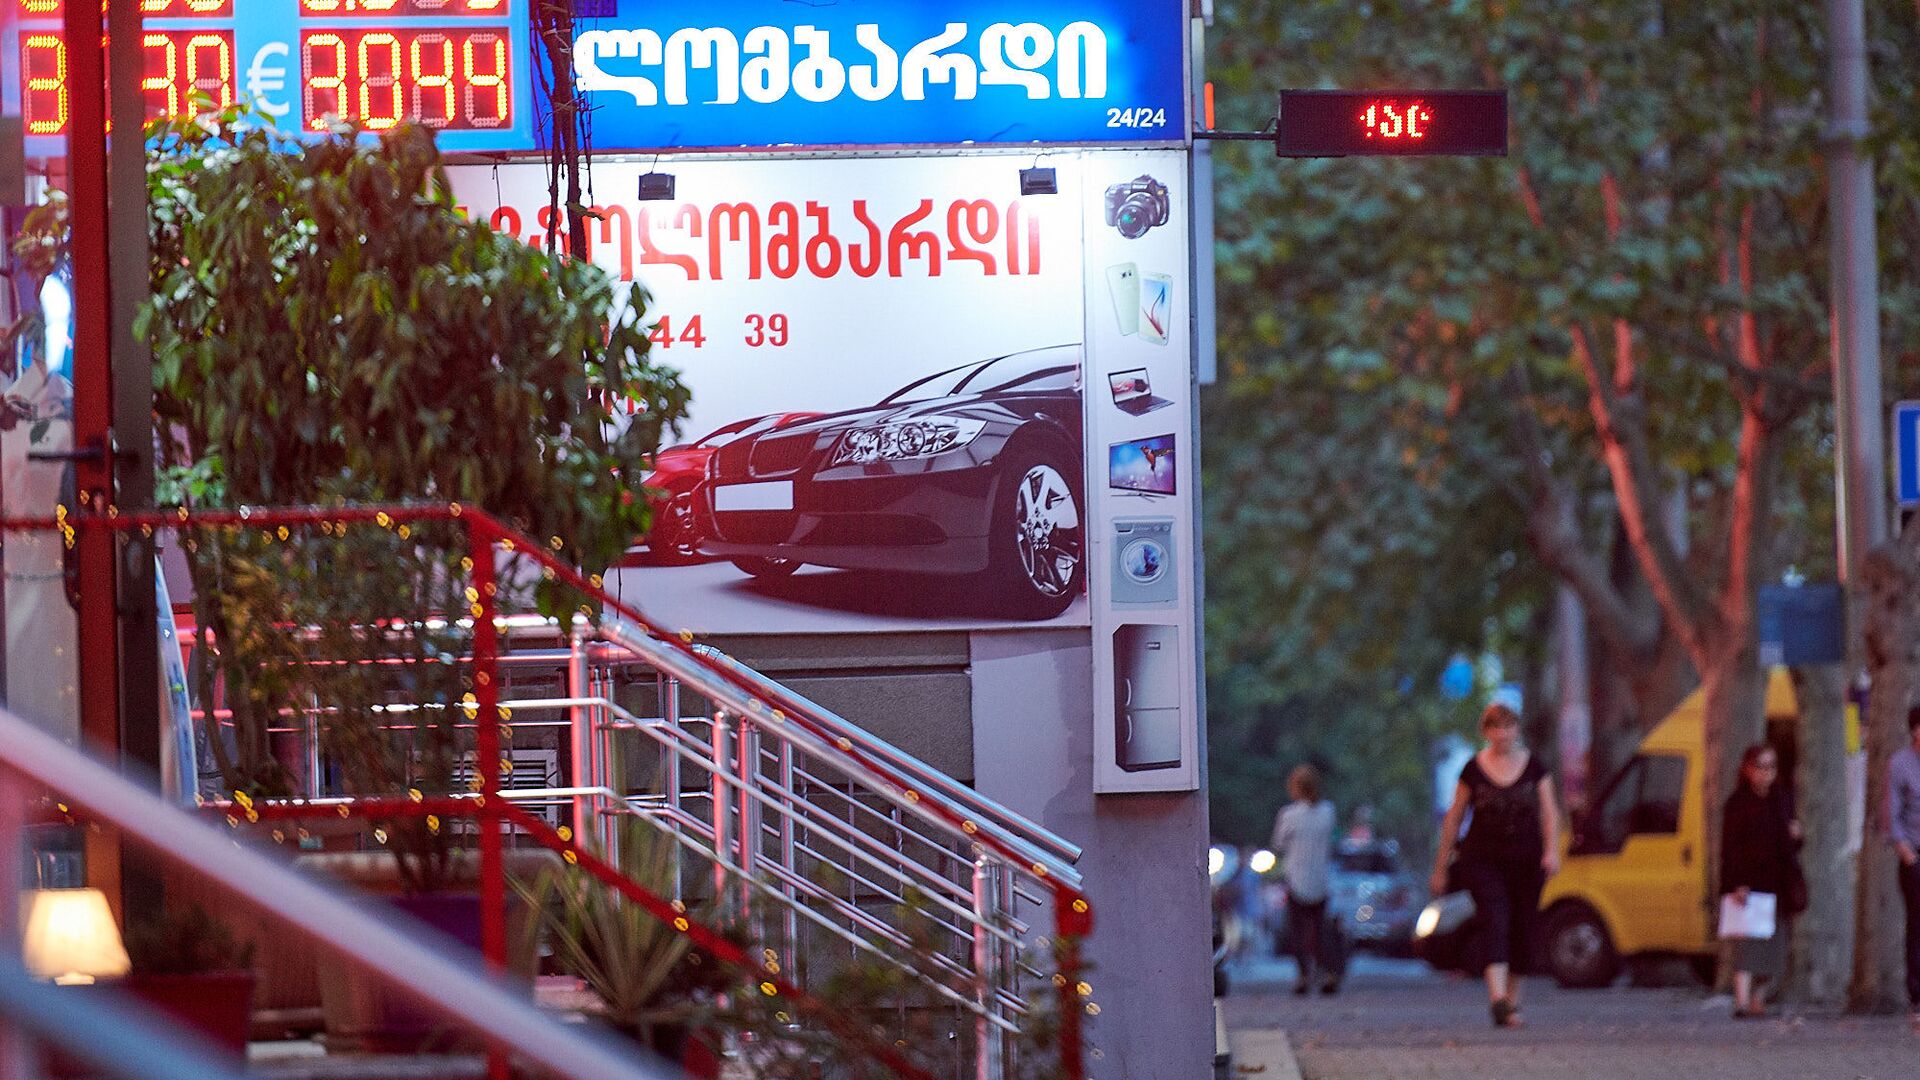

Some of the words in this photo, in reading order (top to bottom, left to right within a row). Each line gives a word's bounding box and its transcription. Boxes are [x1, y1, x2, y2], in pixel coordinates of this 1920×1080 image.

[246, 41, 289, 116] €
[573, 21, 1108, 106] ლომბარდი
[1106, 107, 1167, 128] 24/24
[455, 198, 1041, 283] ტოლომბარდი
[744, 313, 789, 348] 39
